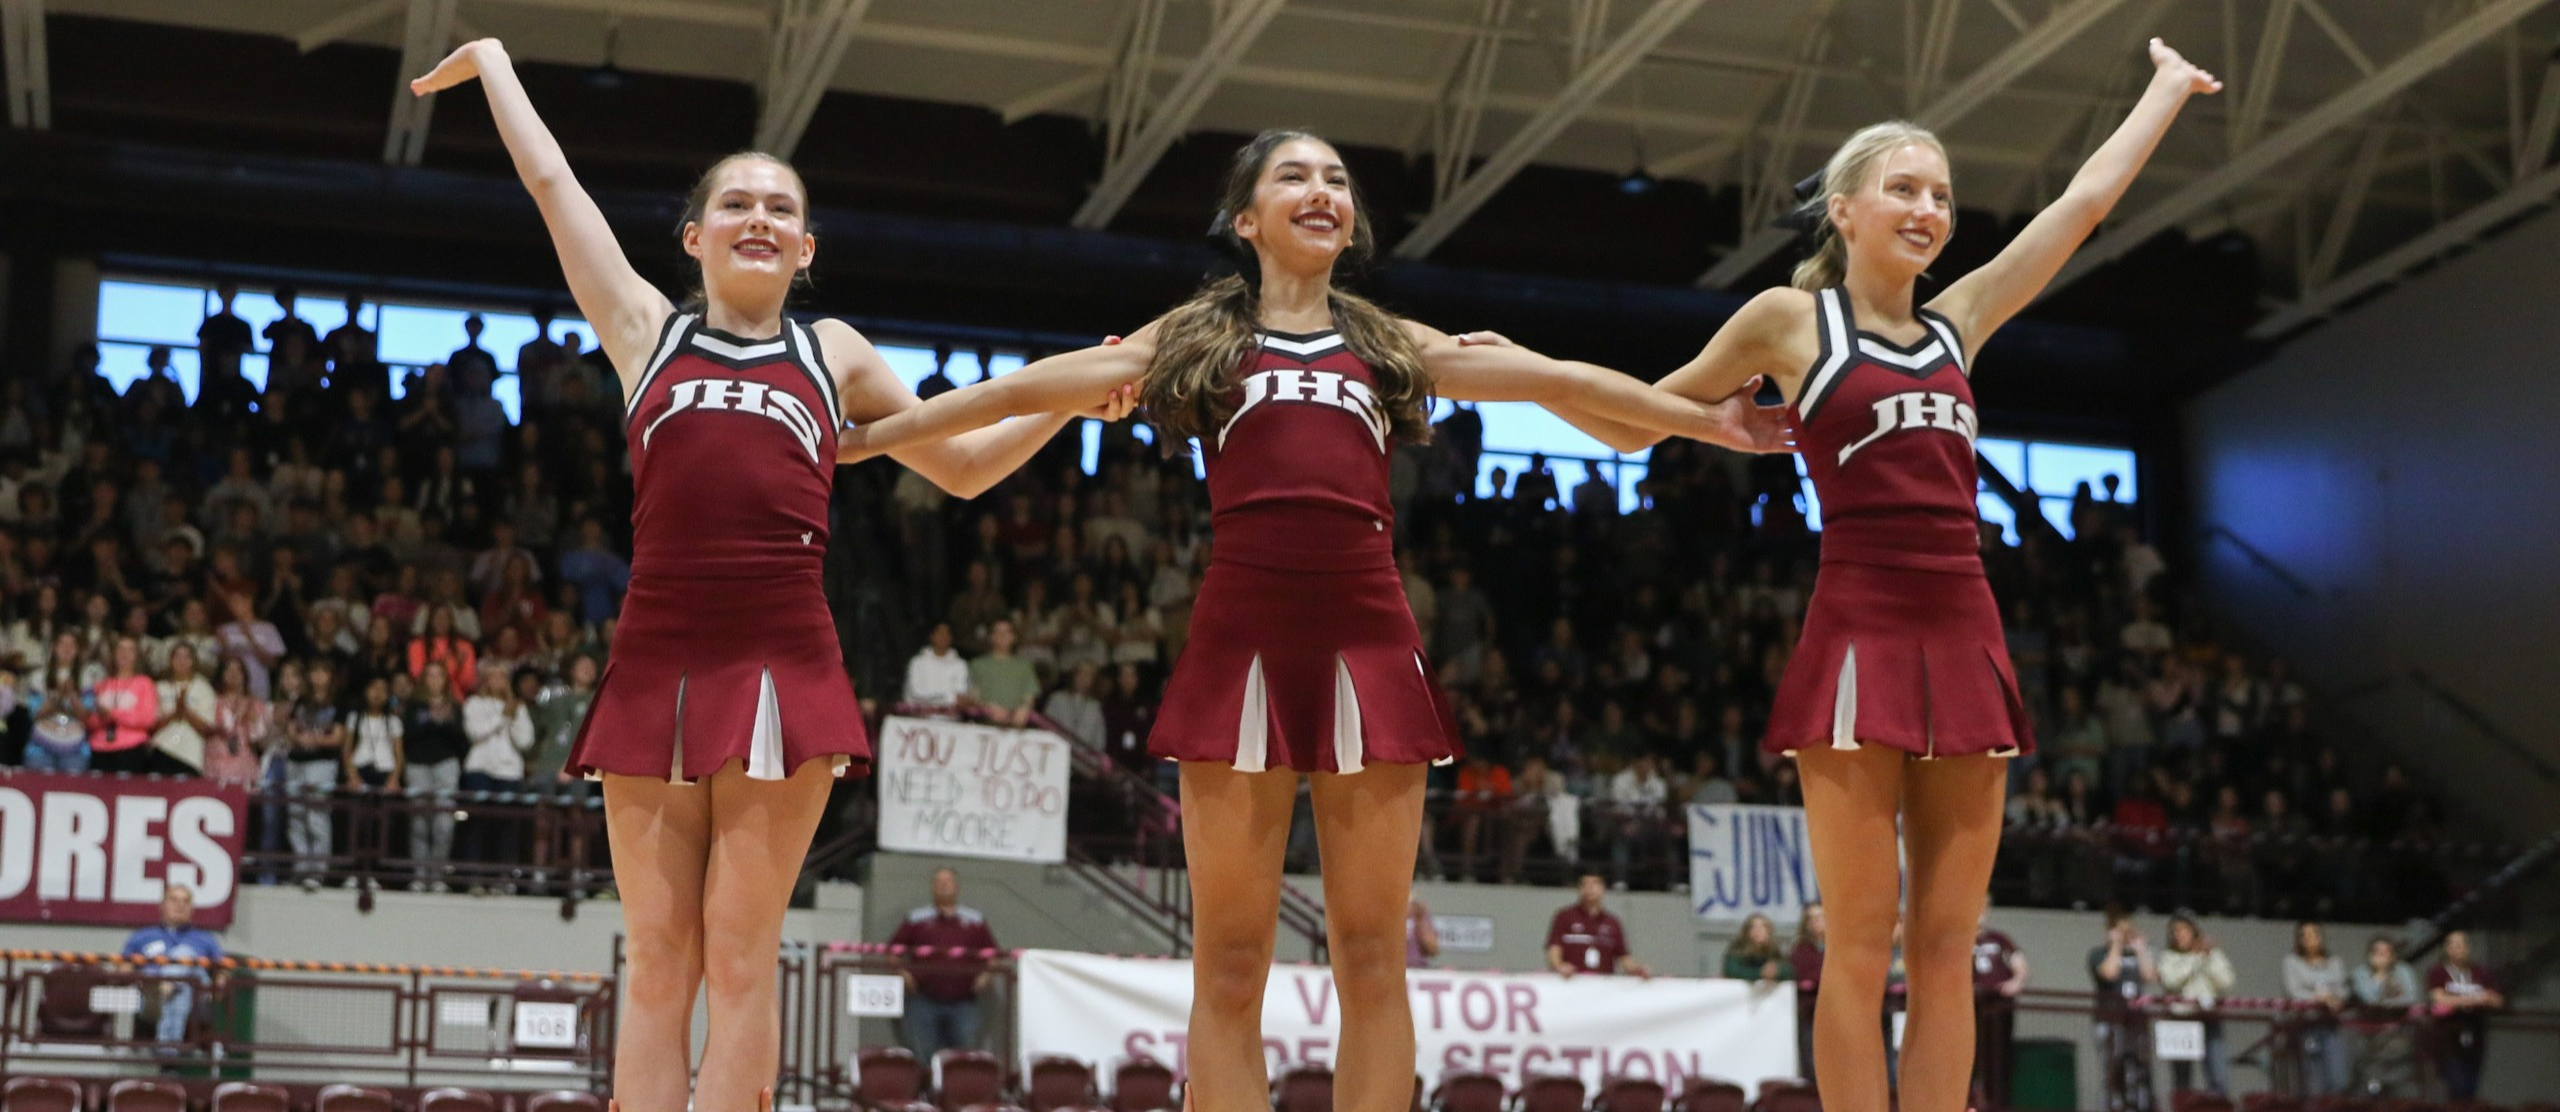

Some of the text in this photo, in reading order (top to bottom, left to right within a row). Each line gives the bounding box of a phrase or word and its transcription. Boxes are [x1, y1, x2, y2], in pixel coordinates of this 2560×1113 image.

[642, 379, 822, 464] JHS
[1218, 369, 1392, 455] JHS
[1838, 392, 1978, 466] JHS
[896, 725, 1060, 776] YOU JUST
[886, 768, 964, 804] NEED
[1019, 782, 1062, 816] DO
[1295, 974, 1541, 1033] VTOR
